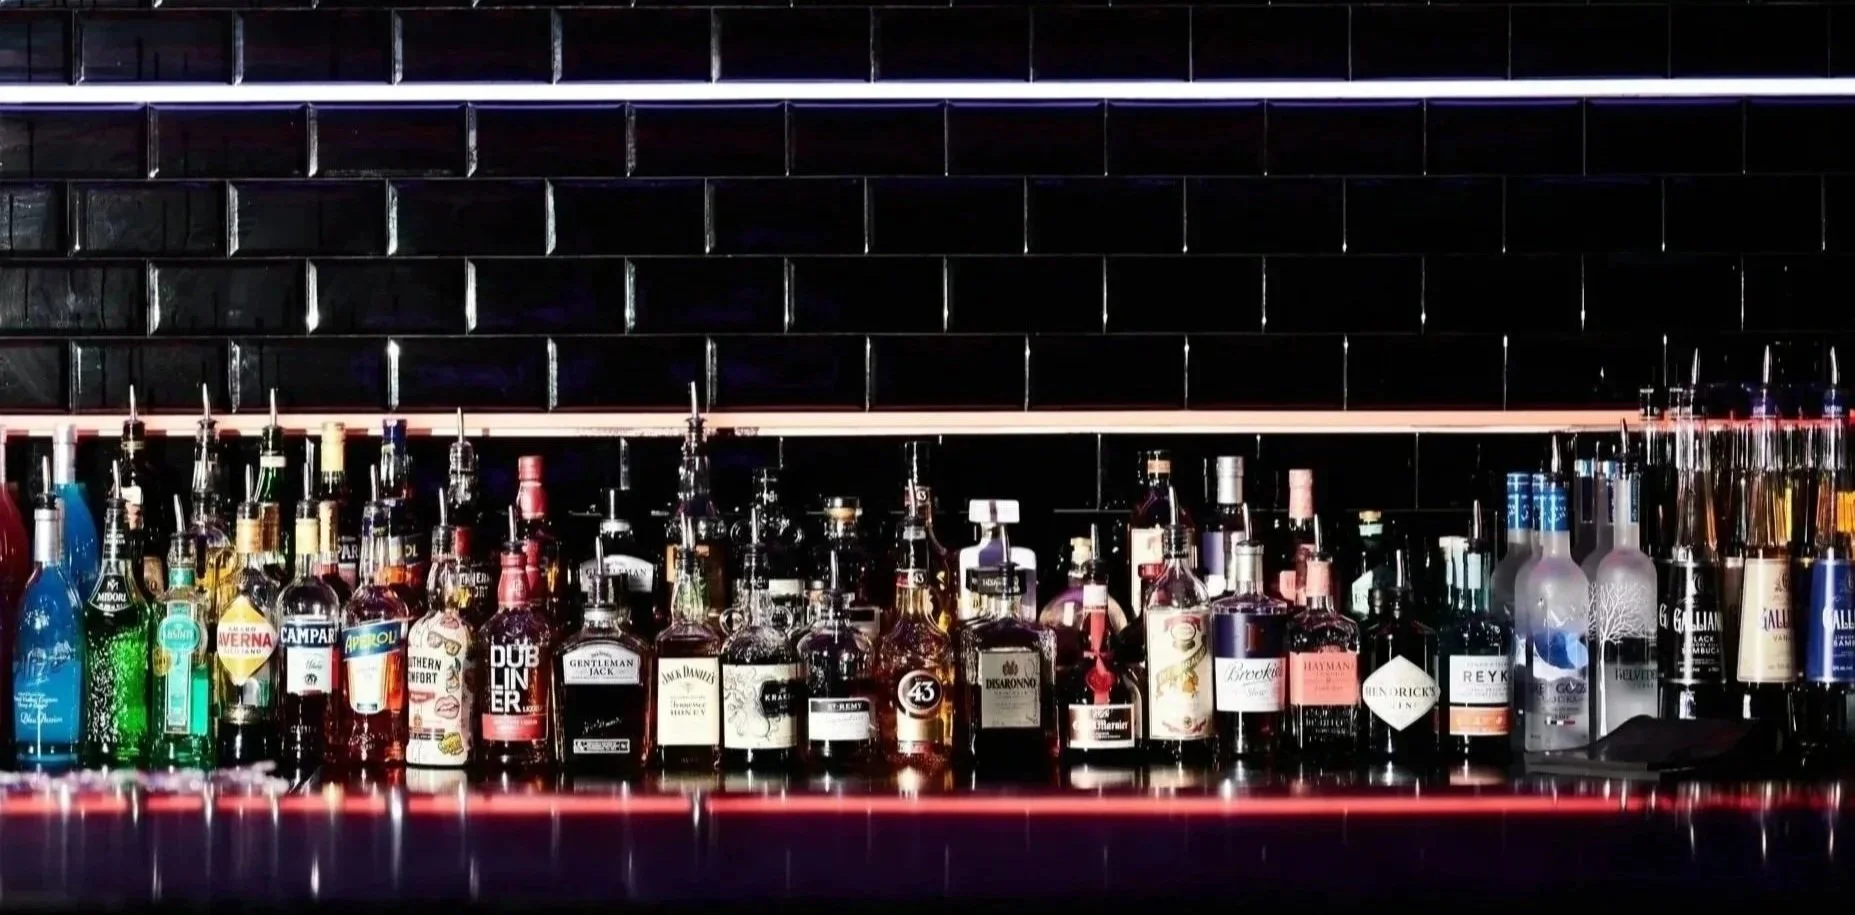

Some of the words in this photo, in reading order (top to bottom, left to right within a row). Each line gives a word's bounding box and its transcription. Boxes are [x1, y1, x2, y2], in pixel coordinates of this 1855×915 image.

[97, 592, 127, 602] MIDORI
[218, 631, 273, 649] AVERNA
[344, 629, 397, 655] APEROL
[490, 644, 540, 669] DUB
[569, 659, 634, 668] GENTLEMAN
[490, 667, 529, 691] LIN
[590, 667, 614, 676] JACK
[662, 668, 682, 685] JACK
[907, 680, 935, 702] 43
[985, 677, 1037, 690] DISARONNO
[1365, 685, 1437, 698] HENDRICK'S
[490, 690, 521, 712] ER
[669, 709, 707, 717] HONEY
